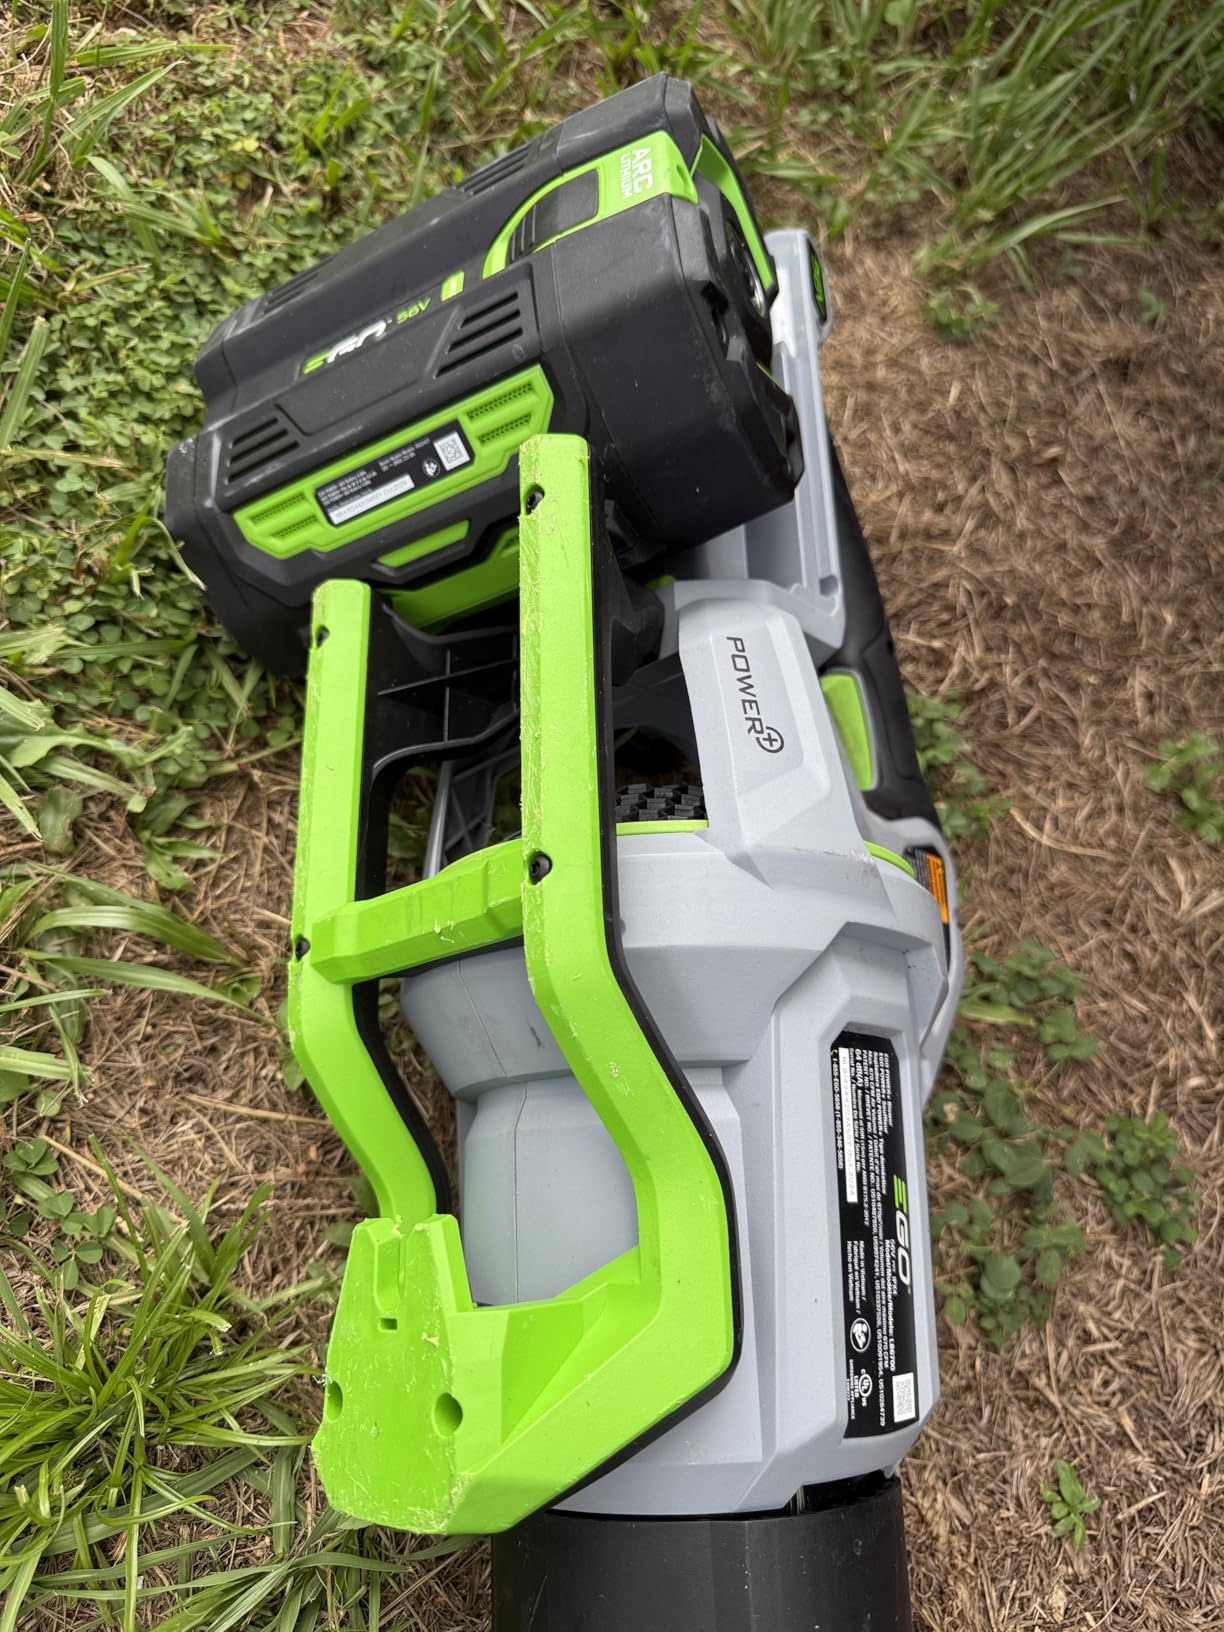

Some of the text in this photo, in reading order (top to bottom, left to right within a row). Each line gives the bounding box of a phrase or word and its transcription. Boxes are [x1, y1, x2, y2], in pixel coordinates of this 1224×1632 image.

[620, 152, 633, 200] LITHIUM
[631, 147, 653, 194] ARC
[397, 297, 431, 324] 56V
[855, 1049, 861, 1061] 64
[855, 1062, 863, 1087] dB(A)
[894, 1174, 910, 1286] EGO
[848, 1263, 852, 1272] en
[854, 1271, 859, 1280] en
